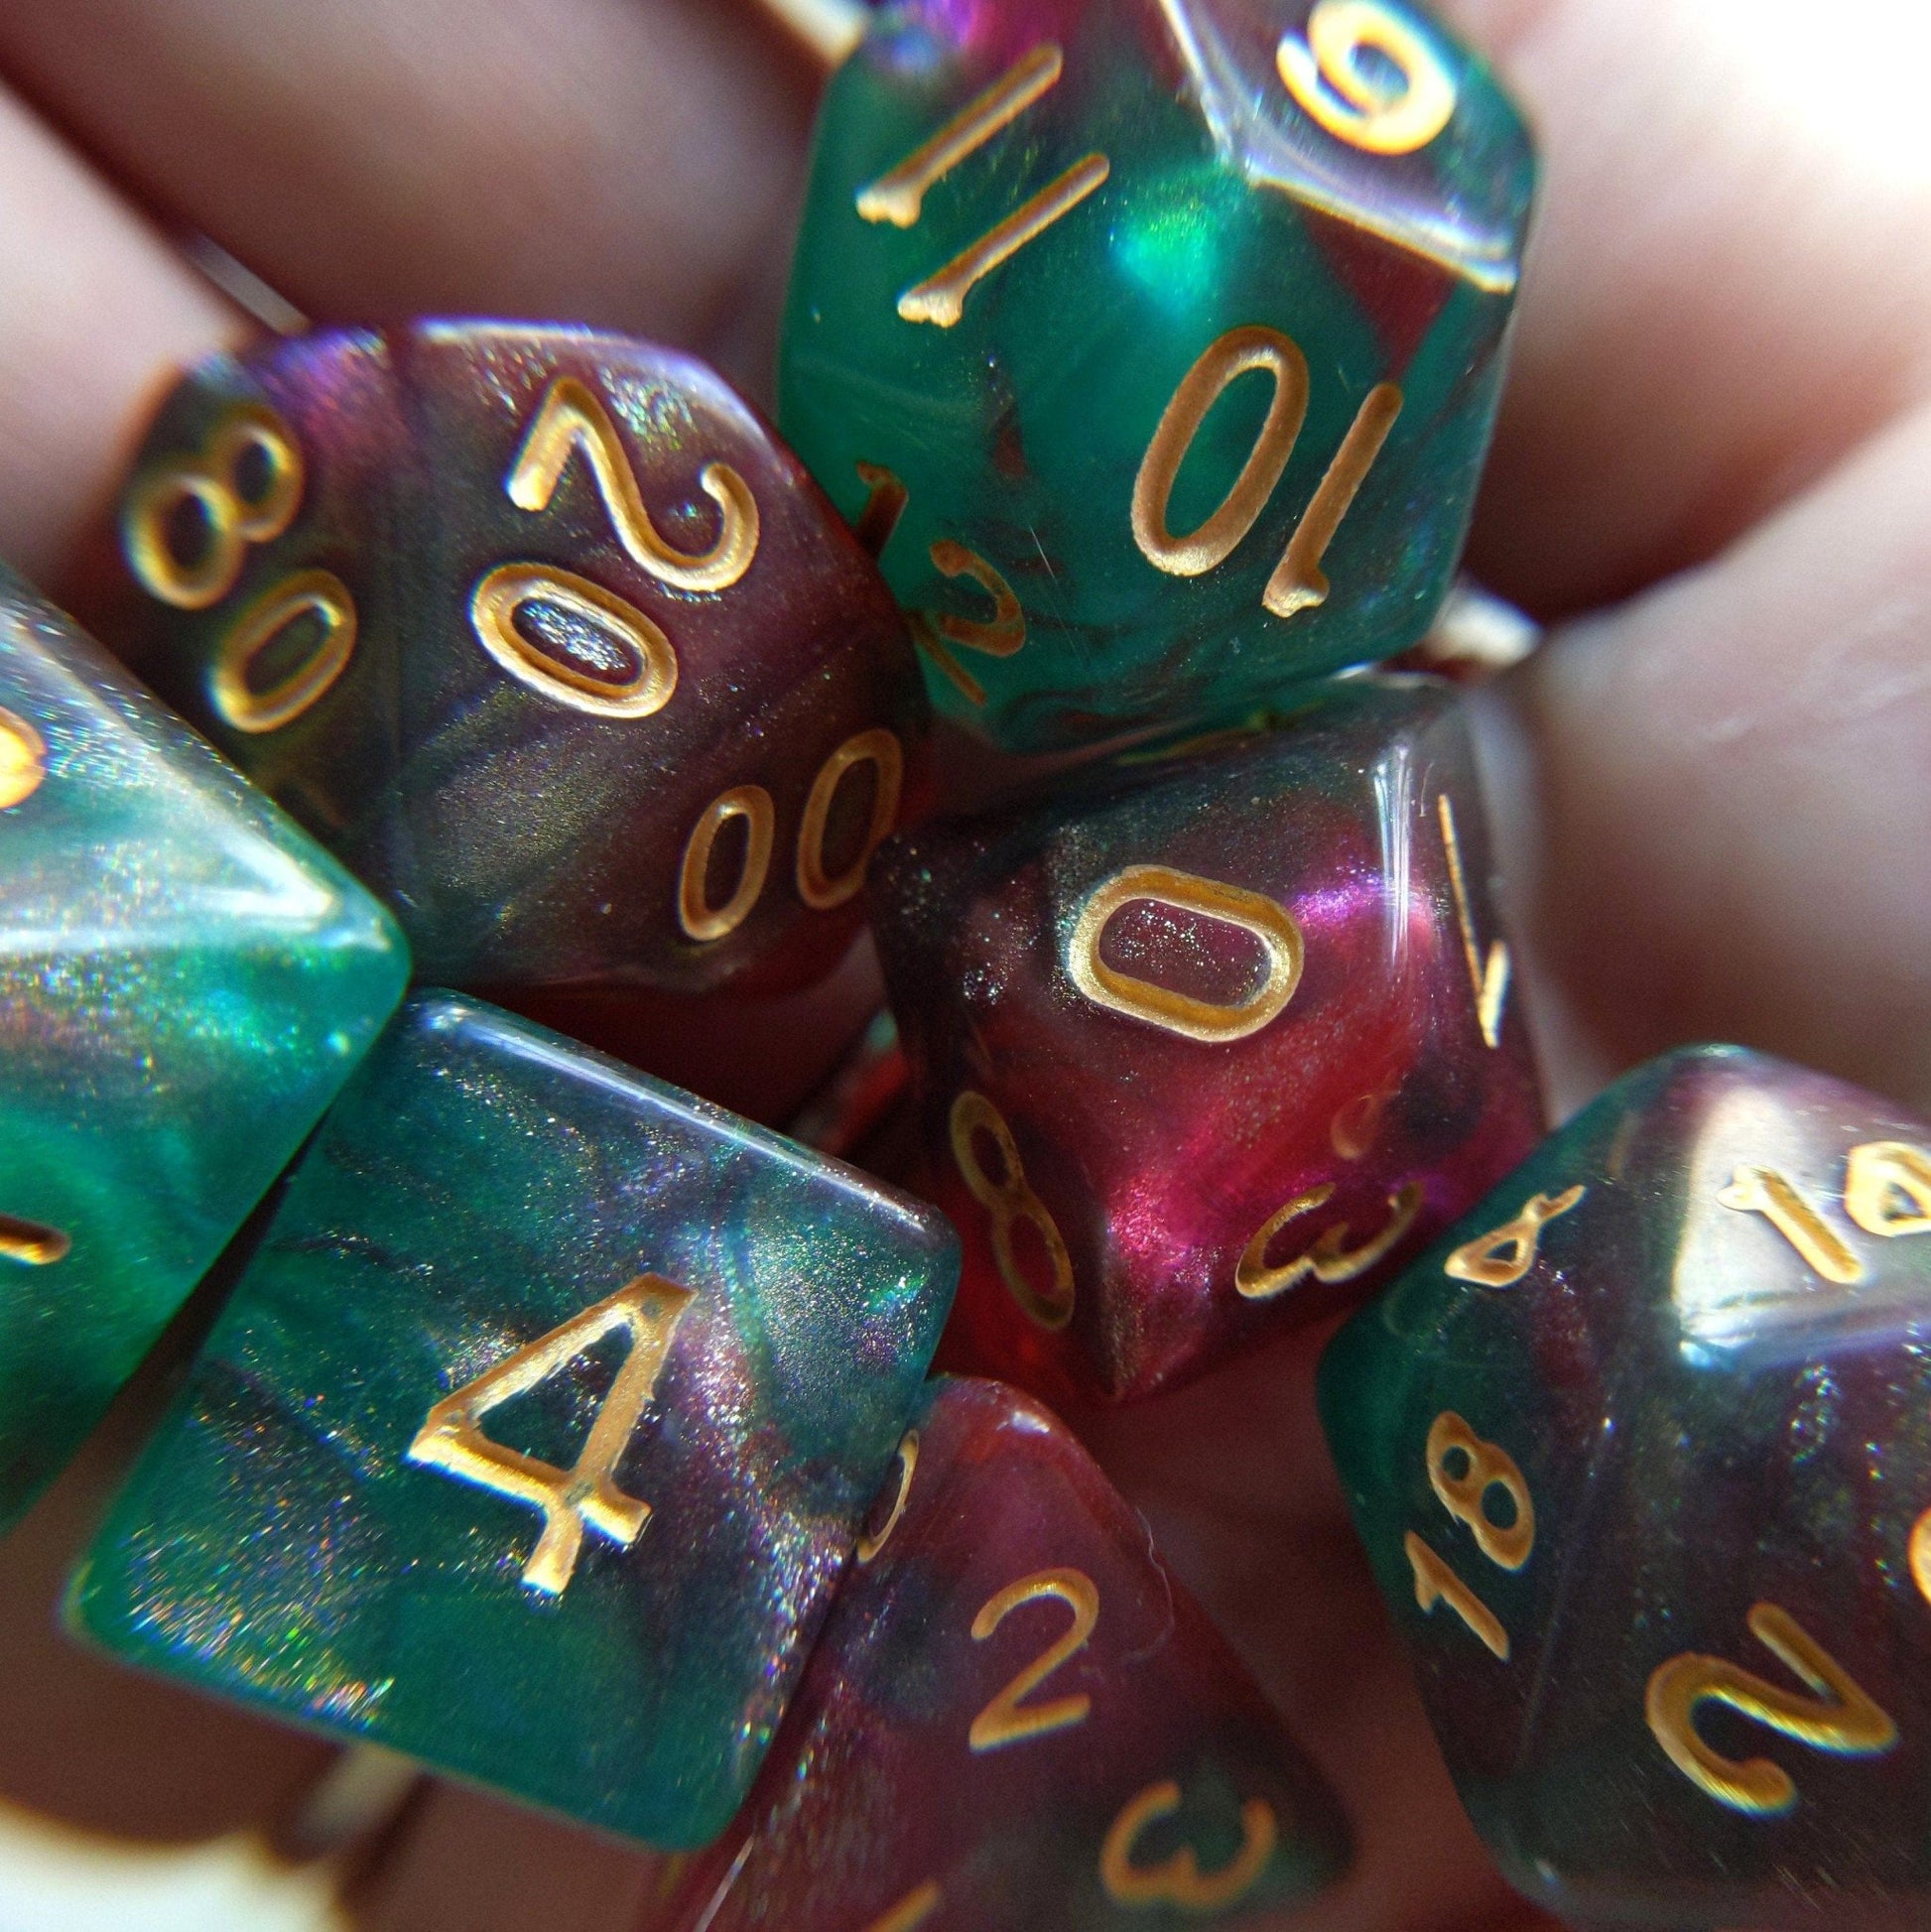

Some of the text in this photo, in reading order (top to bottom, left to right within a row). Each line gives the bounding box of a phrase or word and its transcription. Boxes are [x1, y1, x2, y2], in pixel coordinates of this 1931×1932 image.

[855, 44, 1109, 328] 11
[121, 405, 357, 732] 80
[470, 376, 760, 719] 20
[1130, 325, 1404, 617] 10
[678, 728, 904, 942] 00
[1068, 863, 1305, 1044] 0
[949, 1091, 1076, 1331] 8
[1234, 1181, 1424, 1300] 3
[1444, 1185, 1584, 1287] 4
[407, 1272, 697, 1597] 4
[1404, 1411, 1536, 1661] 18
[968, 1567, 1100, 1752] 2
[1645, 1602, 1897, 1816] 2
[1100, 1781, 1276, 1907] 3
